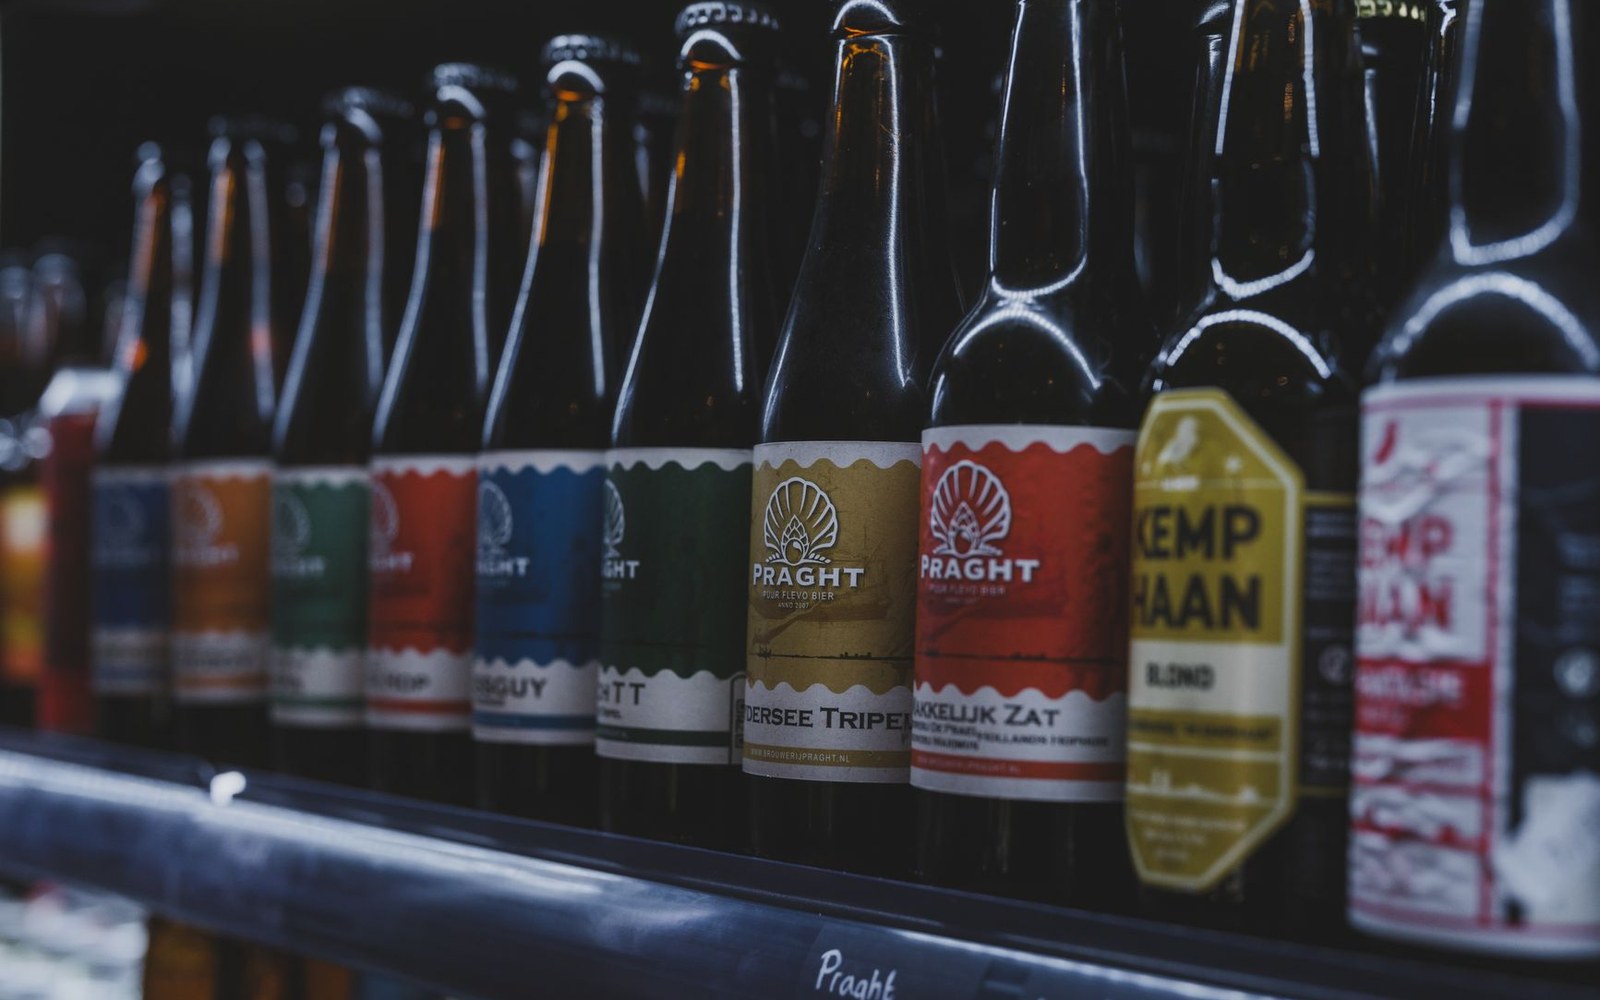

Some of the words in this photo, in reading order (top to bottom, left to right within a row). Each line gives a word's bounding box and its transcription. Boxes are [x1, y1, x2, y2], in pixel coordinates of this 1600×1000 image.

[753, 563, 865, 587] PRAGHT
[920, 554, 1041, 582] PRAGHT
[782, 591, 808, 601] FLEVO
[811, 591, 834, 601] BIER
[1003, 704, 1061, 727] ZAT
